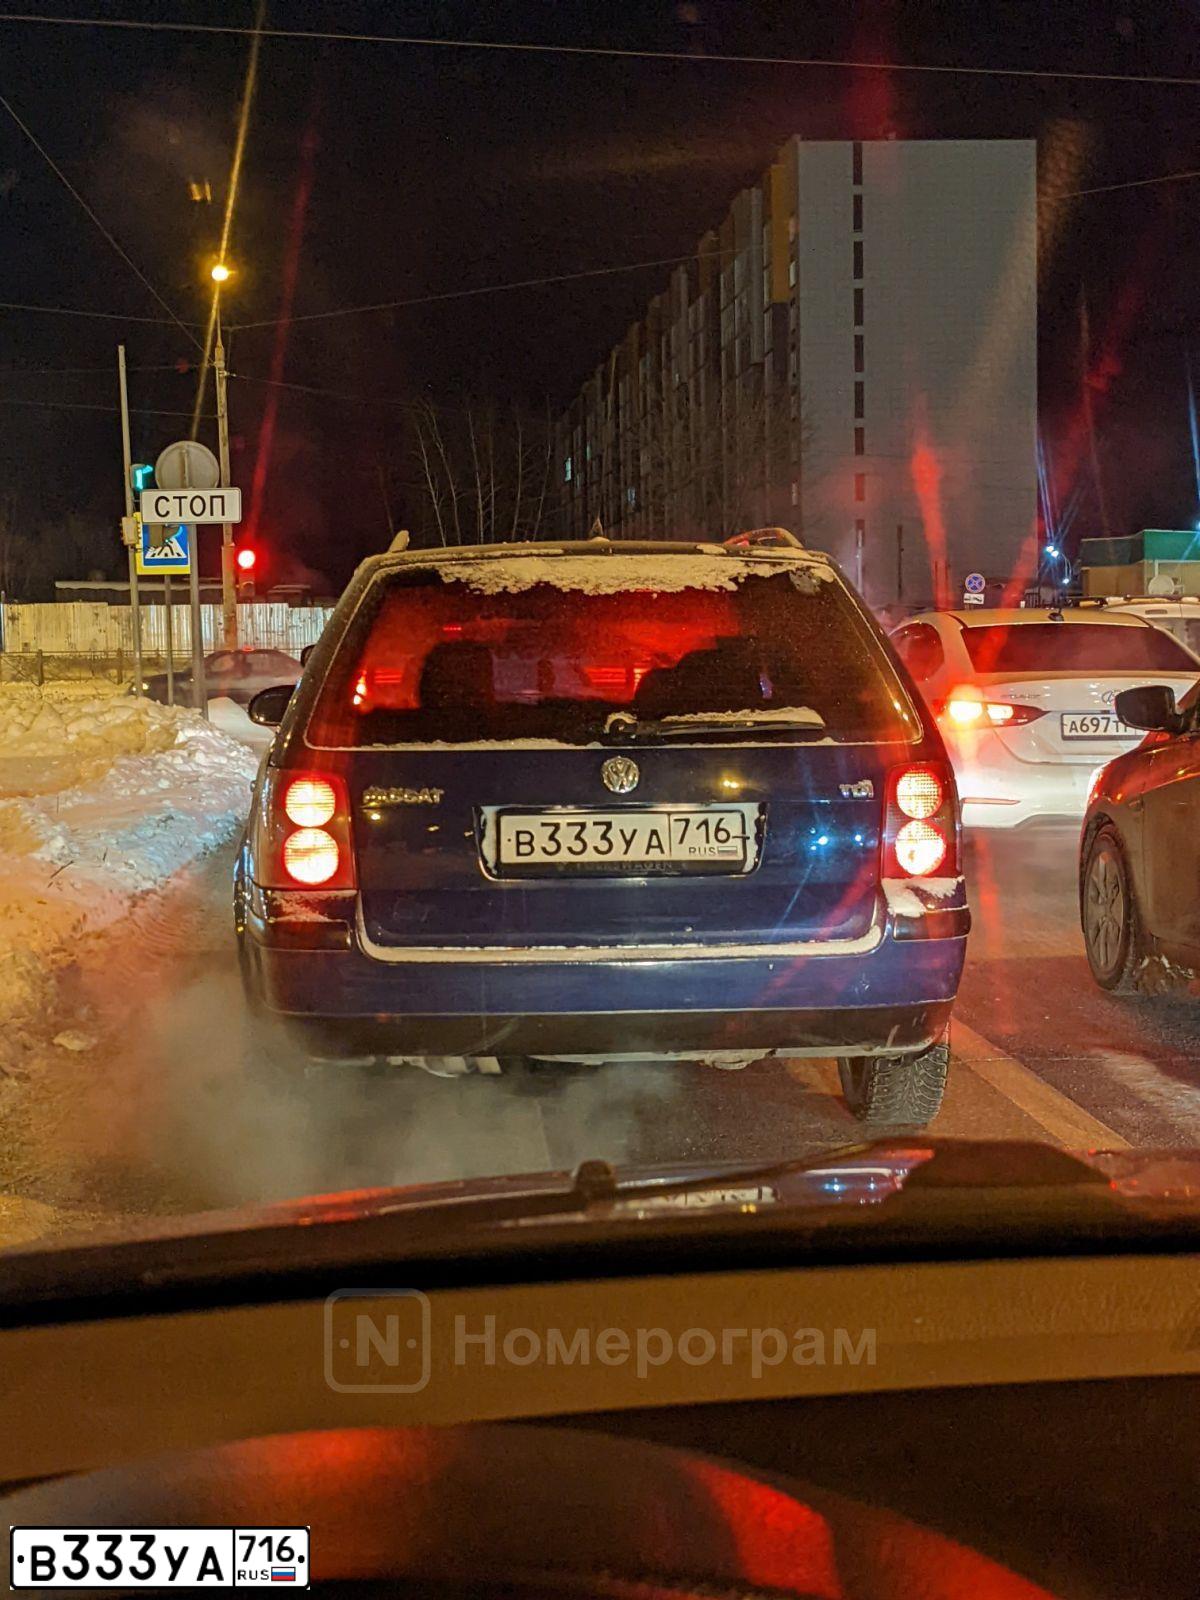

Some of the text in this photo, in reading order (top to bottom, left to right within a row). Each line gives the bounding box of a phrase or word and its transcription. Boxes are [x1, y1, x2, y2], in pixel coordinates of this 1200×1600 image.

[154, 495, 226, 518] СТОП
[515, 817, 732, 857] В333УА 716
[688, 846, 717, 857] RUS
